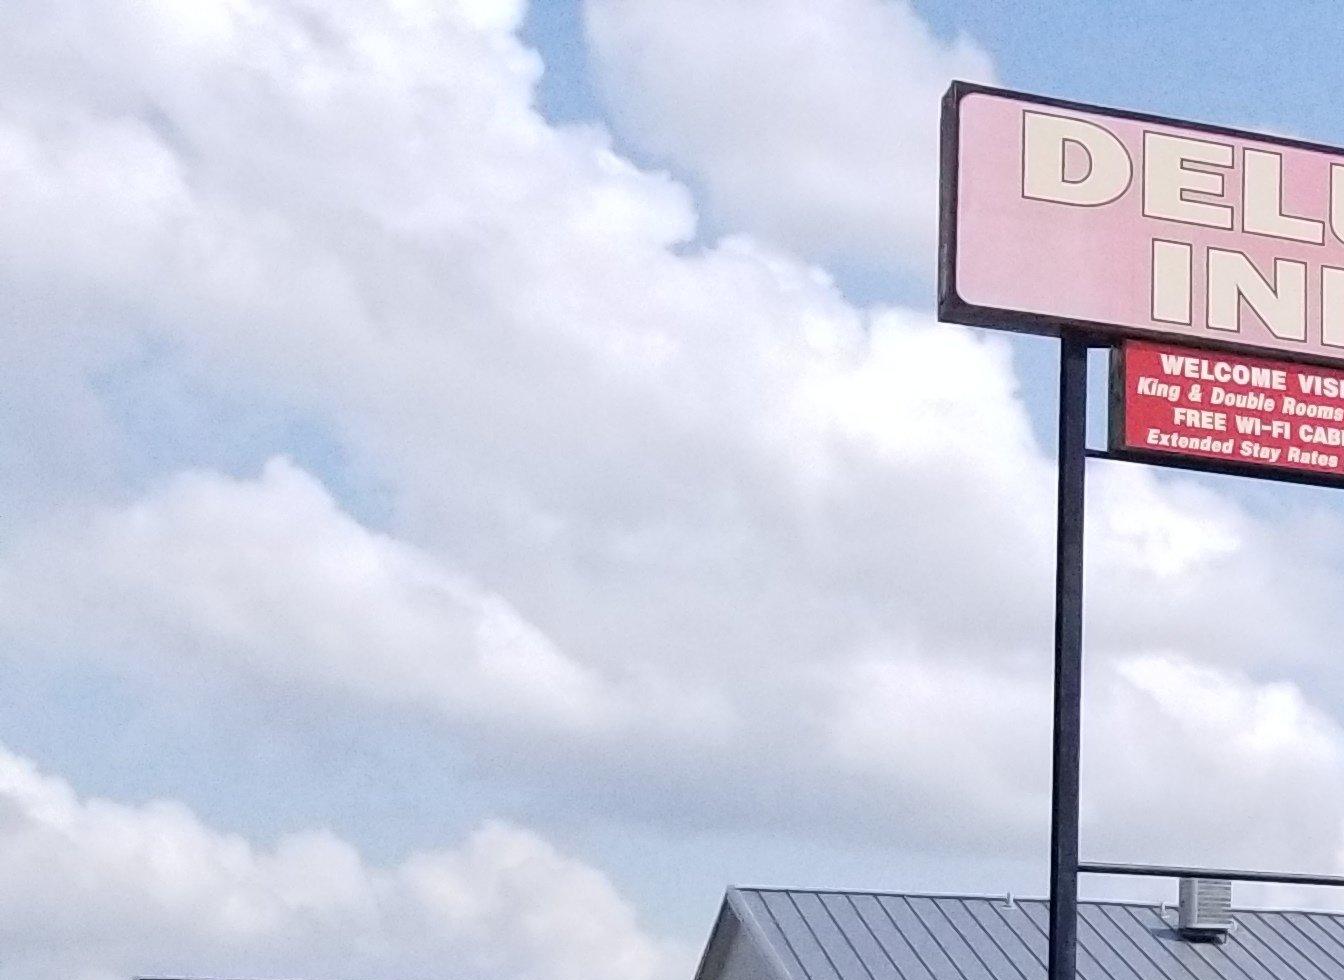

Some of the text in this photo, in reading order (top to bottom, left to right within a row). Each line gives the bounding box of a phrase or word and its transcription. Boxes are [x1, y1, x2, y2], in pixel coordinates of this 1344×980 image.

[1160, 353, 1287, 391] WELCOME
[1137, 376, 1181, 402] King
[1188, 384, 1203, 403] &
[1210, 386, 1275, 412] Double
[1281, 396, 1344, 422] Rooms
[1173, 407, 1227, 431] FREE
[1235, 415, 1291, 440] WI-FI
[1147, 428, 1234, 454] Extended
[1239, 441, 1282, 463] Stay
[1287, 450, 1338, 468] Rates
